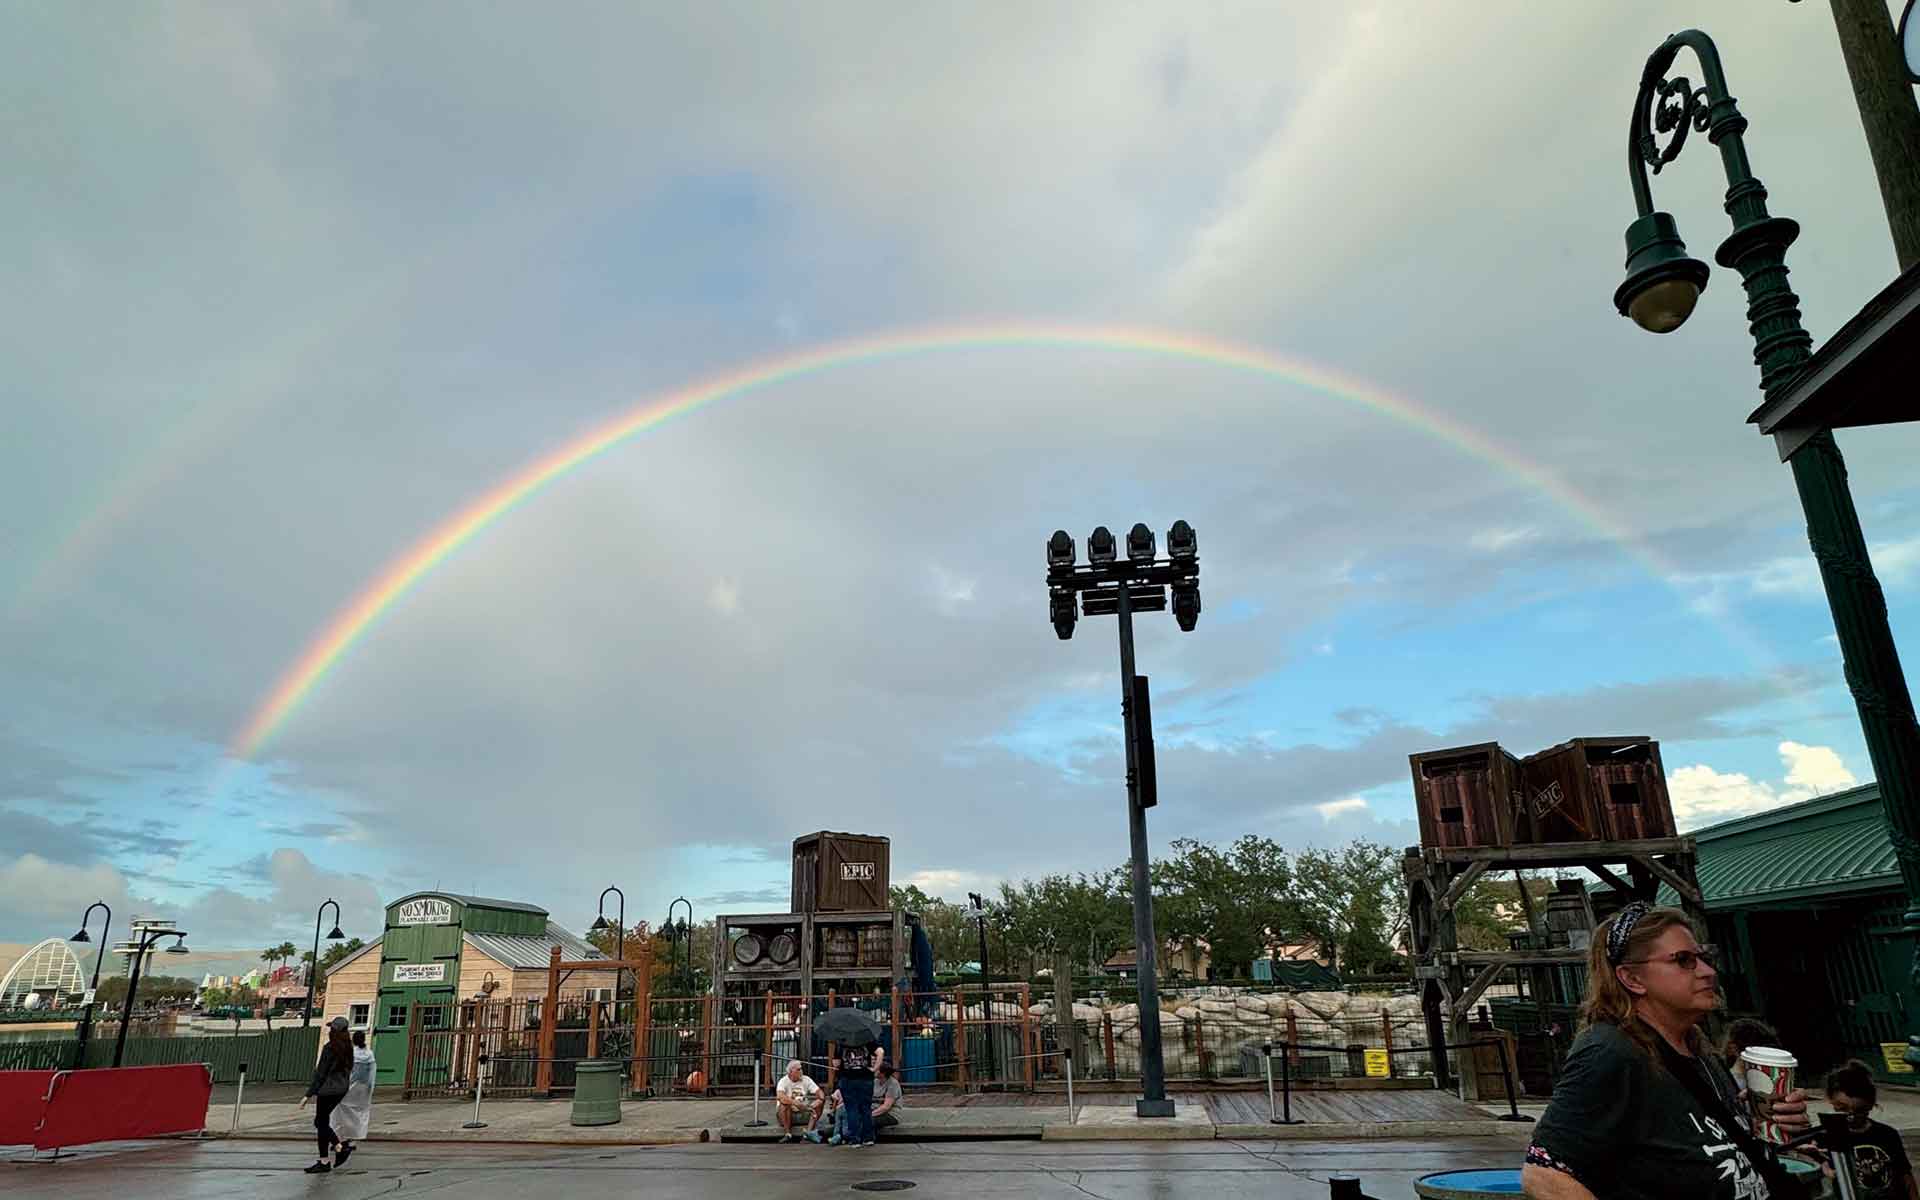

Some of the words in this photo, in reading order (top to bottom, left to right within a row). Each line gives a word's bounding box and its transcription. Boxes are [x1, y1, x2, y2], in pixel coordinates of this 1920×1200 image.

[843, 865, 873, 877] EPIC
[401, 904, 413, 916] NO
[413, 901, 449, 916] SMOKING
